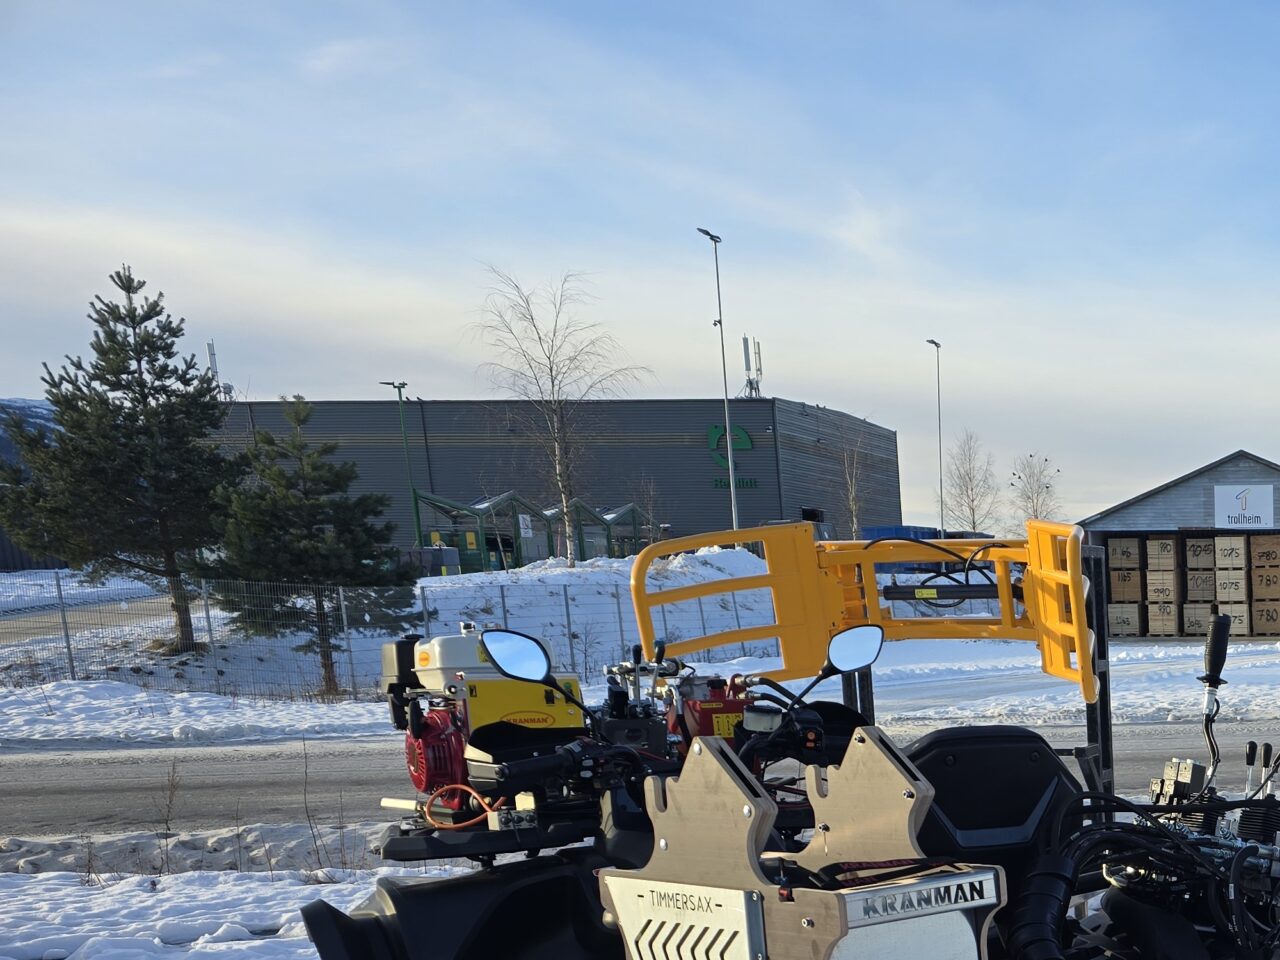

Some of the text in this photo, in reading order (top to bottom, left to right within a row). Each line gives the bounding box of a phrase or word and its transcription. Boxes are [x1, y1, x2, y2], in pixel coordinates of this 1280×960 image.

[1227, 513, 1262, 525] trollheim
[1219, 547, 1241, 558] 1075
[1257, 550, 1278, 561] 780
[1219, 581, 1241, 591] 1075
[1257, 574, 1278, 587] 780
[1153, 587, 1171, 598] 990
[1256, 607, 1279, 622] 780
[649, 889, 714, 914] TIMMERSAX
[863, 880, 986, 919] KRANMAN
